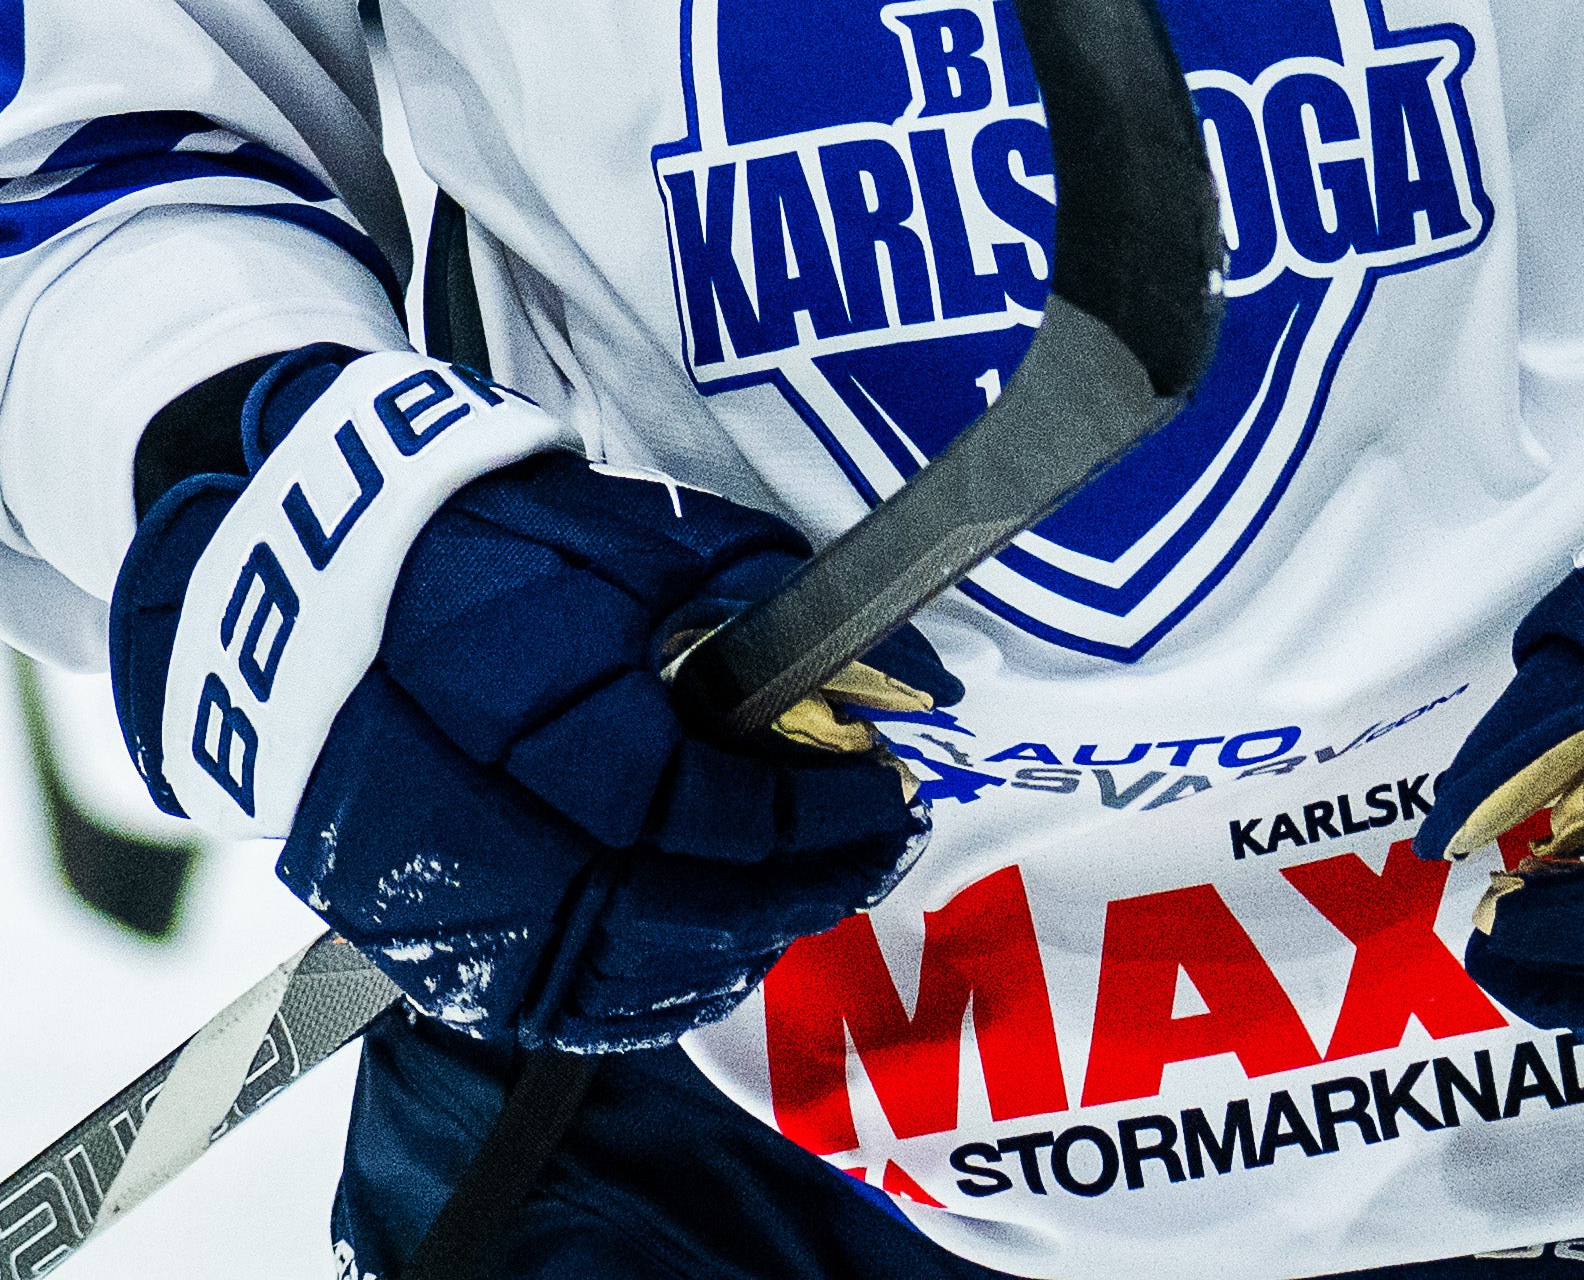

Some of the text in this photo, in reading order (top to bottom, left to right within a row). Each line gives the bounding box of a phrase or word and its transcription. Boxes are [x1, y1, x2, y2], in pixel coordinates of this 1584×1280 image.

[661, 59, 1474, 370] KARLSOGA
[191, 362, 505, 818] BAUE
[982, 725, 1303, 769] AUTO
[1228, 769, 1450, 860] KARLSK
[762, 808, 1554, 1156] MAX
